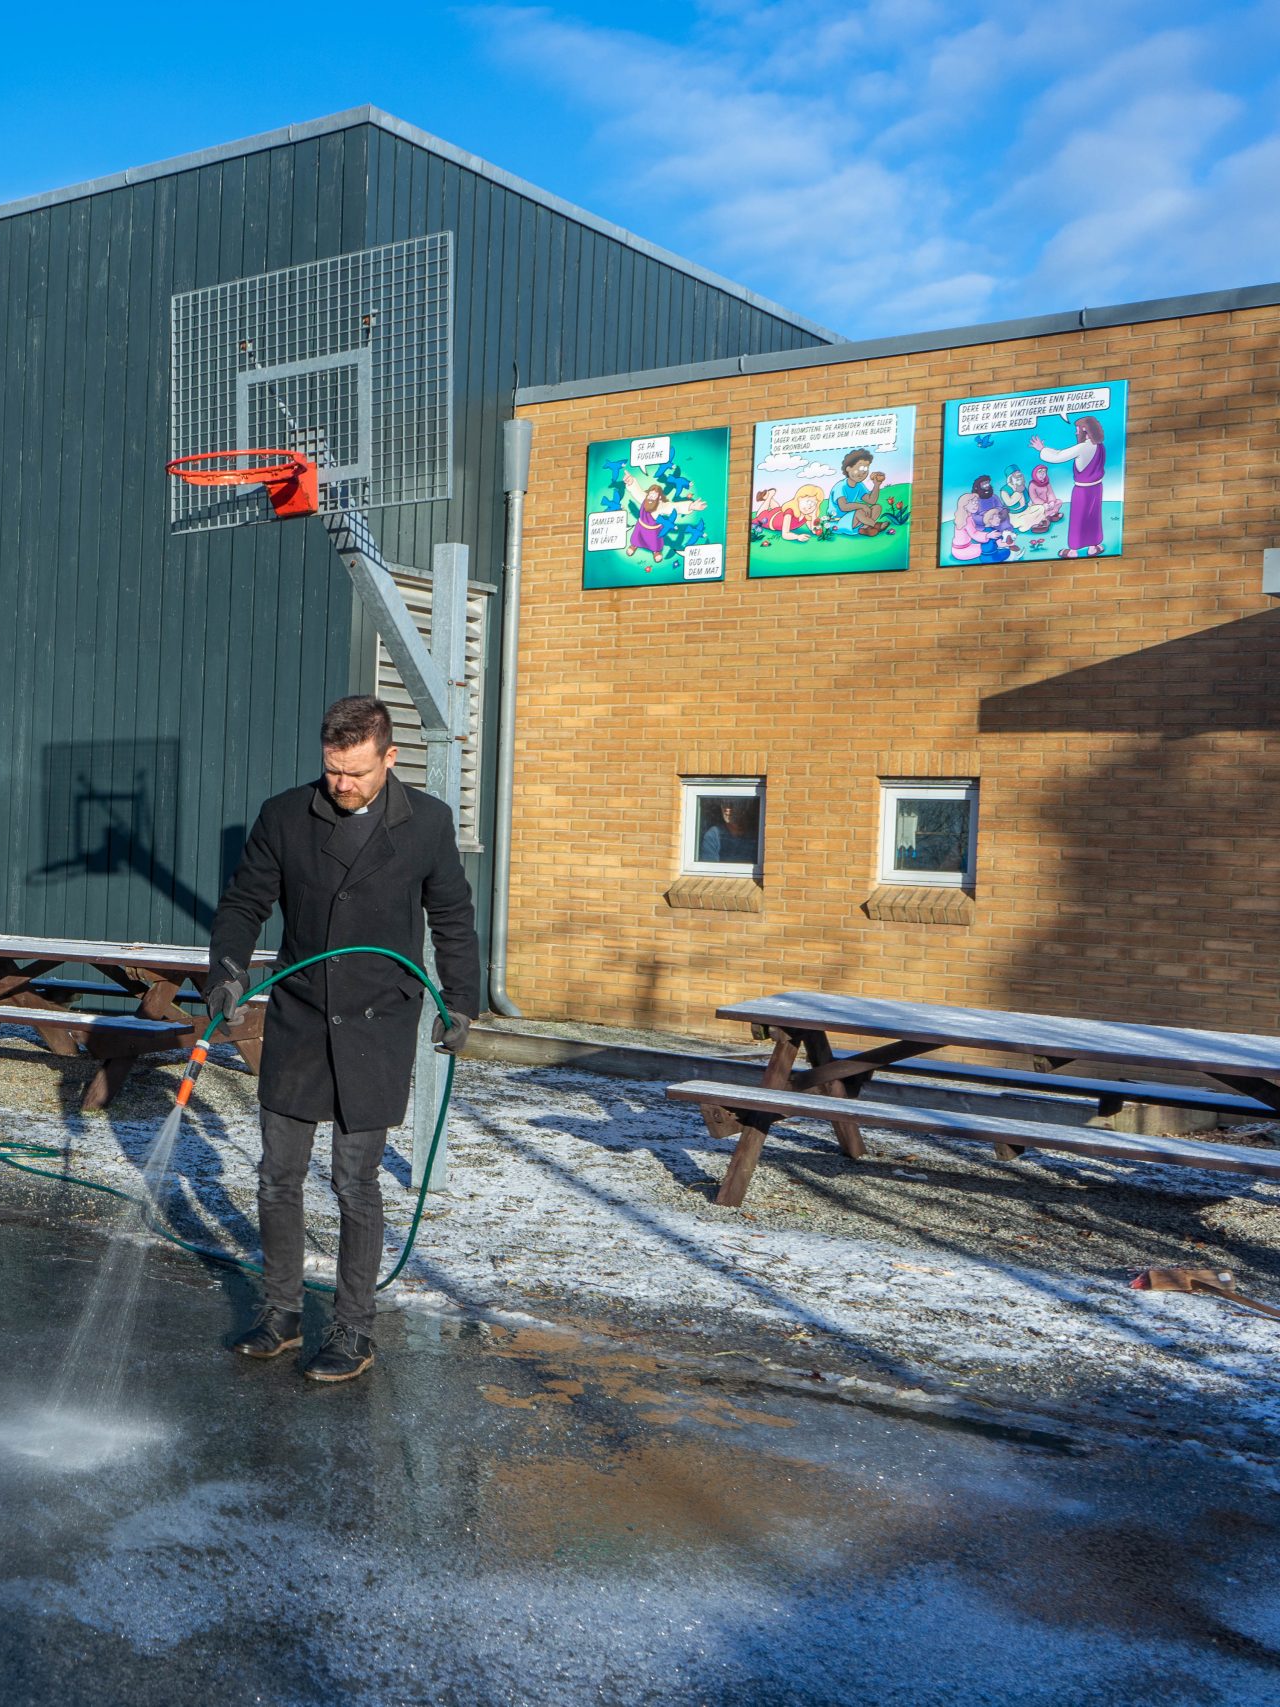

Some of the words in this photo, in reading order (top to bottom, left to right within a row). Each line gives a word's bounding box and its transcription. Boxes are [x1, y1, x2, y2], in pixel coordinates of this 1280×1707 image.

[982, 403, 991, 411] ER
[993, 402, 1008, 410] MYE
[1011, 397, 1047, 407] VIKTIGERE
[1049, 395, 1065, 403] ENN
[1067, 392, 1095, 401] FUGLER.
[962, 414, 979, 422] DERE
[993, 411, 1007, 419] MYE
[1010, 407, 1046, 417] VIKTIGERE
[1049, 404, 1064, 412] ENN
[1067, 400, 1106, 411] BLOMSTER.
[834, 422, 861, 430] ARBEIDER
[961, 422, 970, 432] SÅ
[973, 423, 988, 431] IKKE
[1009, 418, 1034, 427] REDDE.
[774, 436, 790, 444] LAGER
[638, 442, 645, 451] SE
[647, 440, 655, 449] PÅ
[592, 516, 614, 526] SAMLER
[591, 527, 603, 535] MAT
[601, 535, 618, 544] LÅVE?
[689, 558, 702, 566] GUD
[704, 557, 716, 565] GIR
[689, 568, 702, 576] DEM
